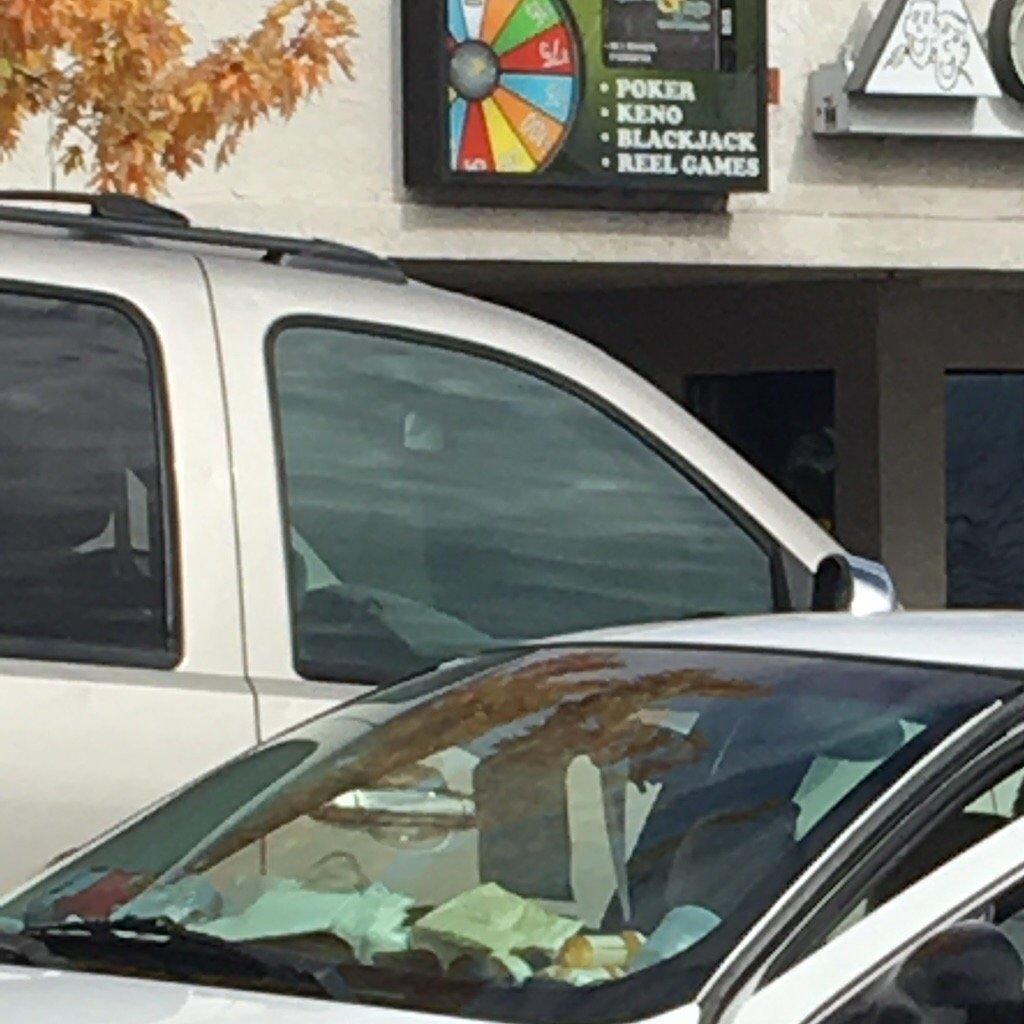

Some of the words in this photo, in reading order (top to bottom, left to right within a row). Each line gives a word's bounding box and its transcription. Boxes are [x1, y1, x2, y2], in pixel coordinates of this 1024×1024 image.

[616, 78, 696, 102] POKER
[616, 102, 684, 126] KENO
[616, 128, 756, 152] BLACKJACK
[617, 153, 678, 174] REEL
[680, 155, 760, 178] GAMES
